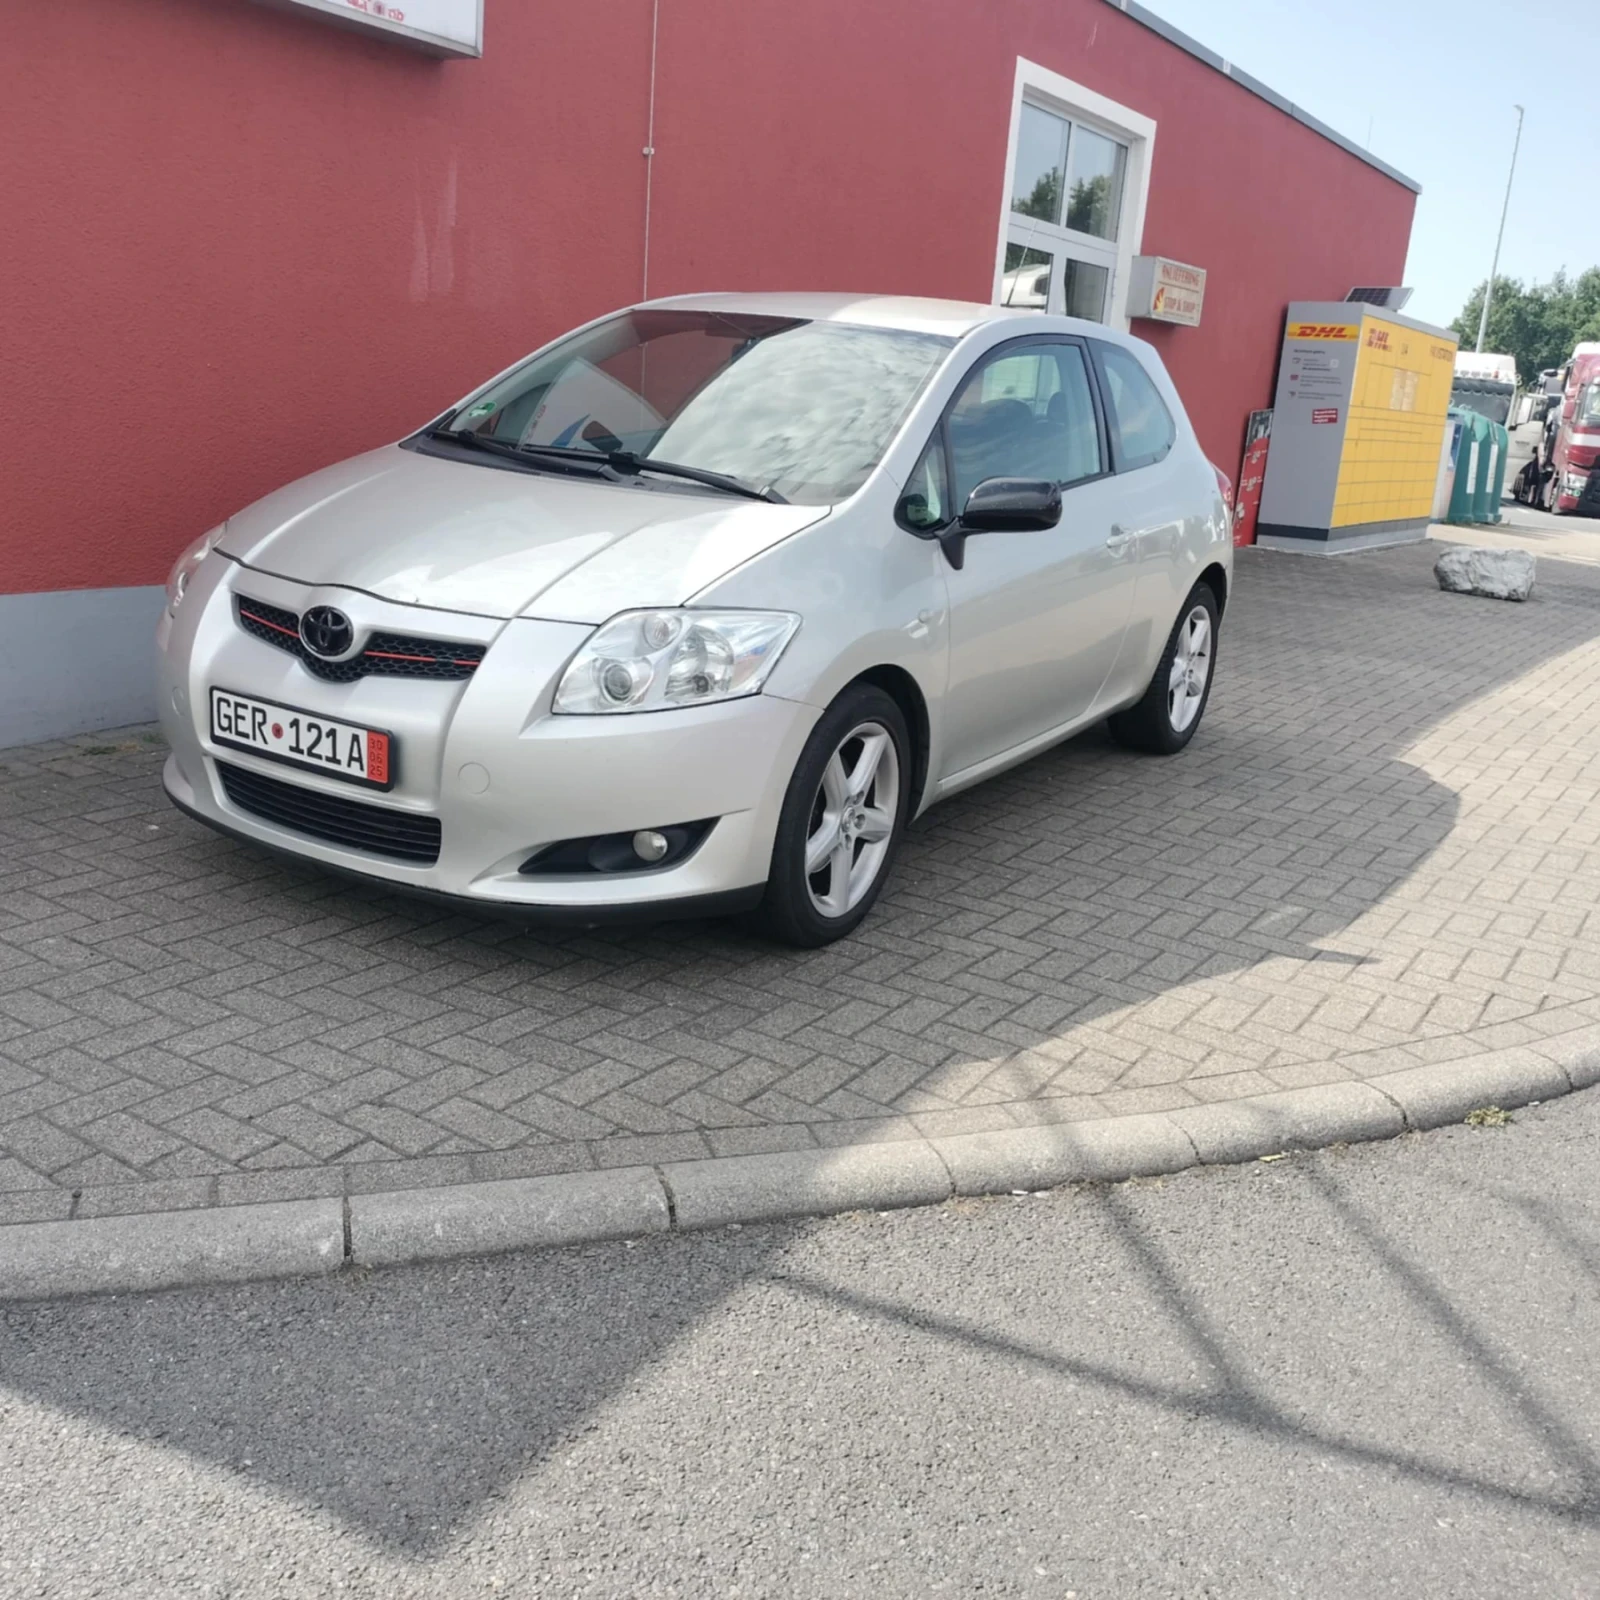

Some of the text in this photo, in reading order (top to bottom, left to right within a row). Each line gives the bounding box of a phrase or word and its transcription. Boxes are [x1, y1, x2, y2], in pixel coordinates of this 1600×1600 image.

[1297, 326, 1347, 338] DHL
[216, 696, 268, 745] GER
[370, 738, 383, 750] 30
[370, 764, 383, 776] 25
